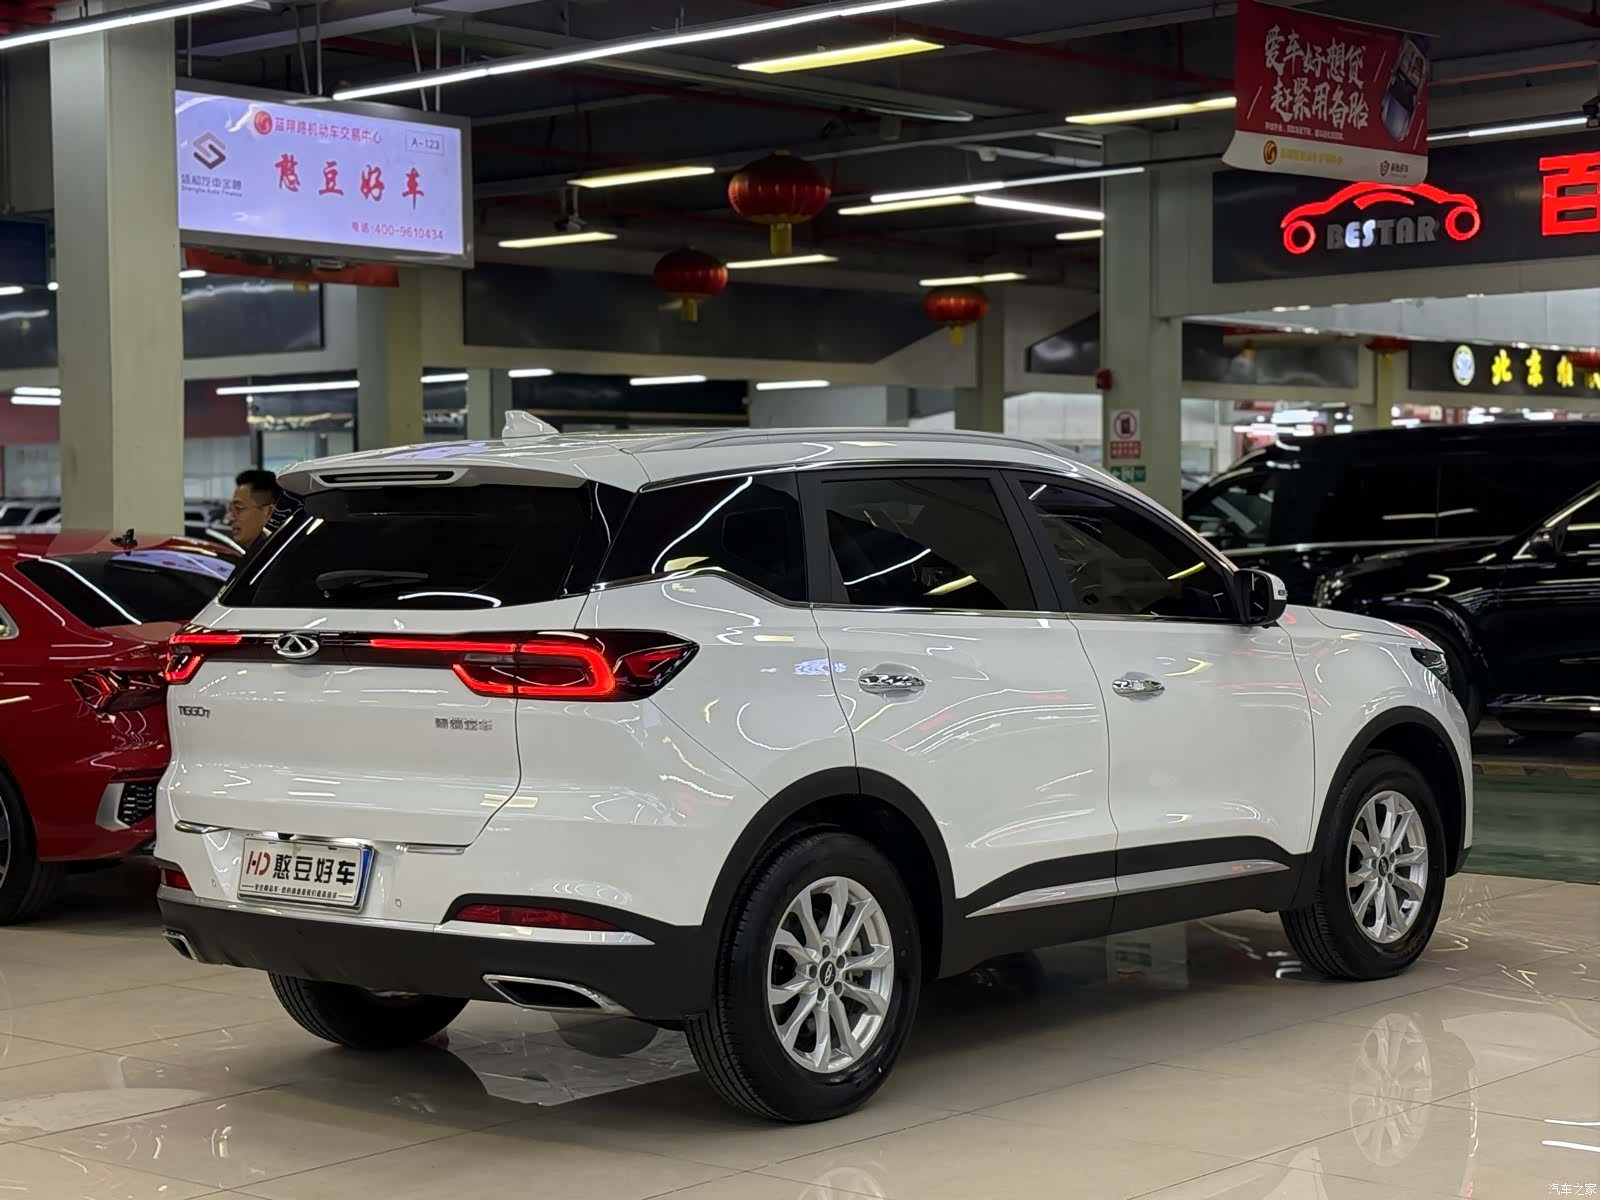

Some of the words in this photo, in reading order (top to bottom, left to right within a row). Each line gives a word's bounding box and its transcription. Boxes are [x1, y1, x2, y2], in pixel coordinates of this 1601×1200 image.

[1265, 24, 1366, 88] 爱车好想贷
[1270, 77, 1369, 130] 赶紧用备胎
[275, 117, 383, 144] 蓝翔路机动车交易中心
[411, 137, 441, 151] A-123
[274, 153, 425, 210] 憨豆好车
[1327, 216, 1438, 250] BESTAR
[272, 854, 357, 885] 憨豆好车
